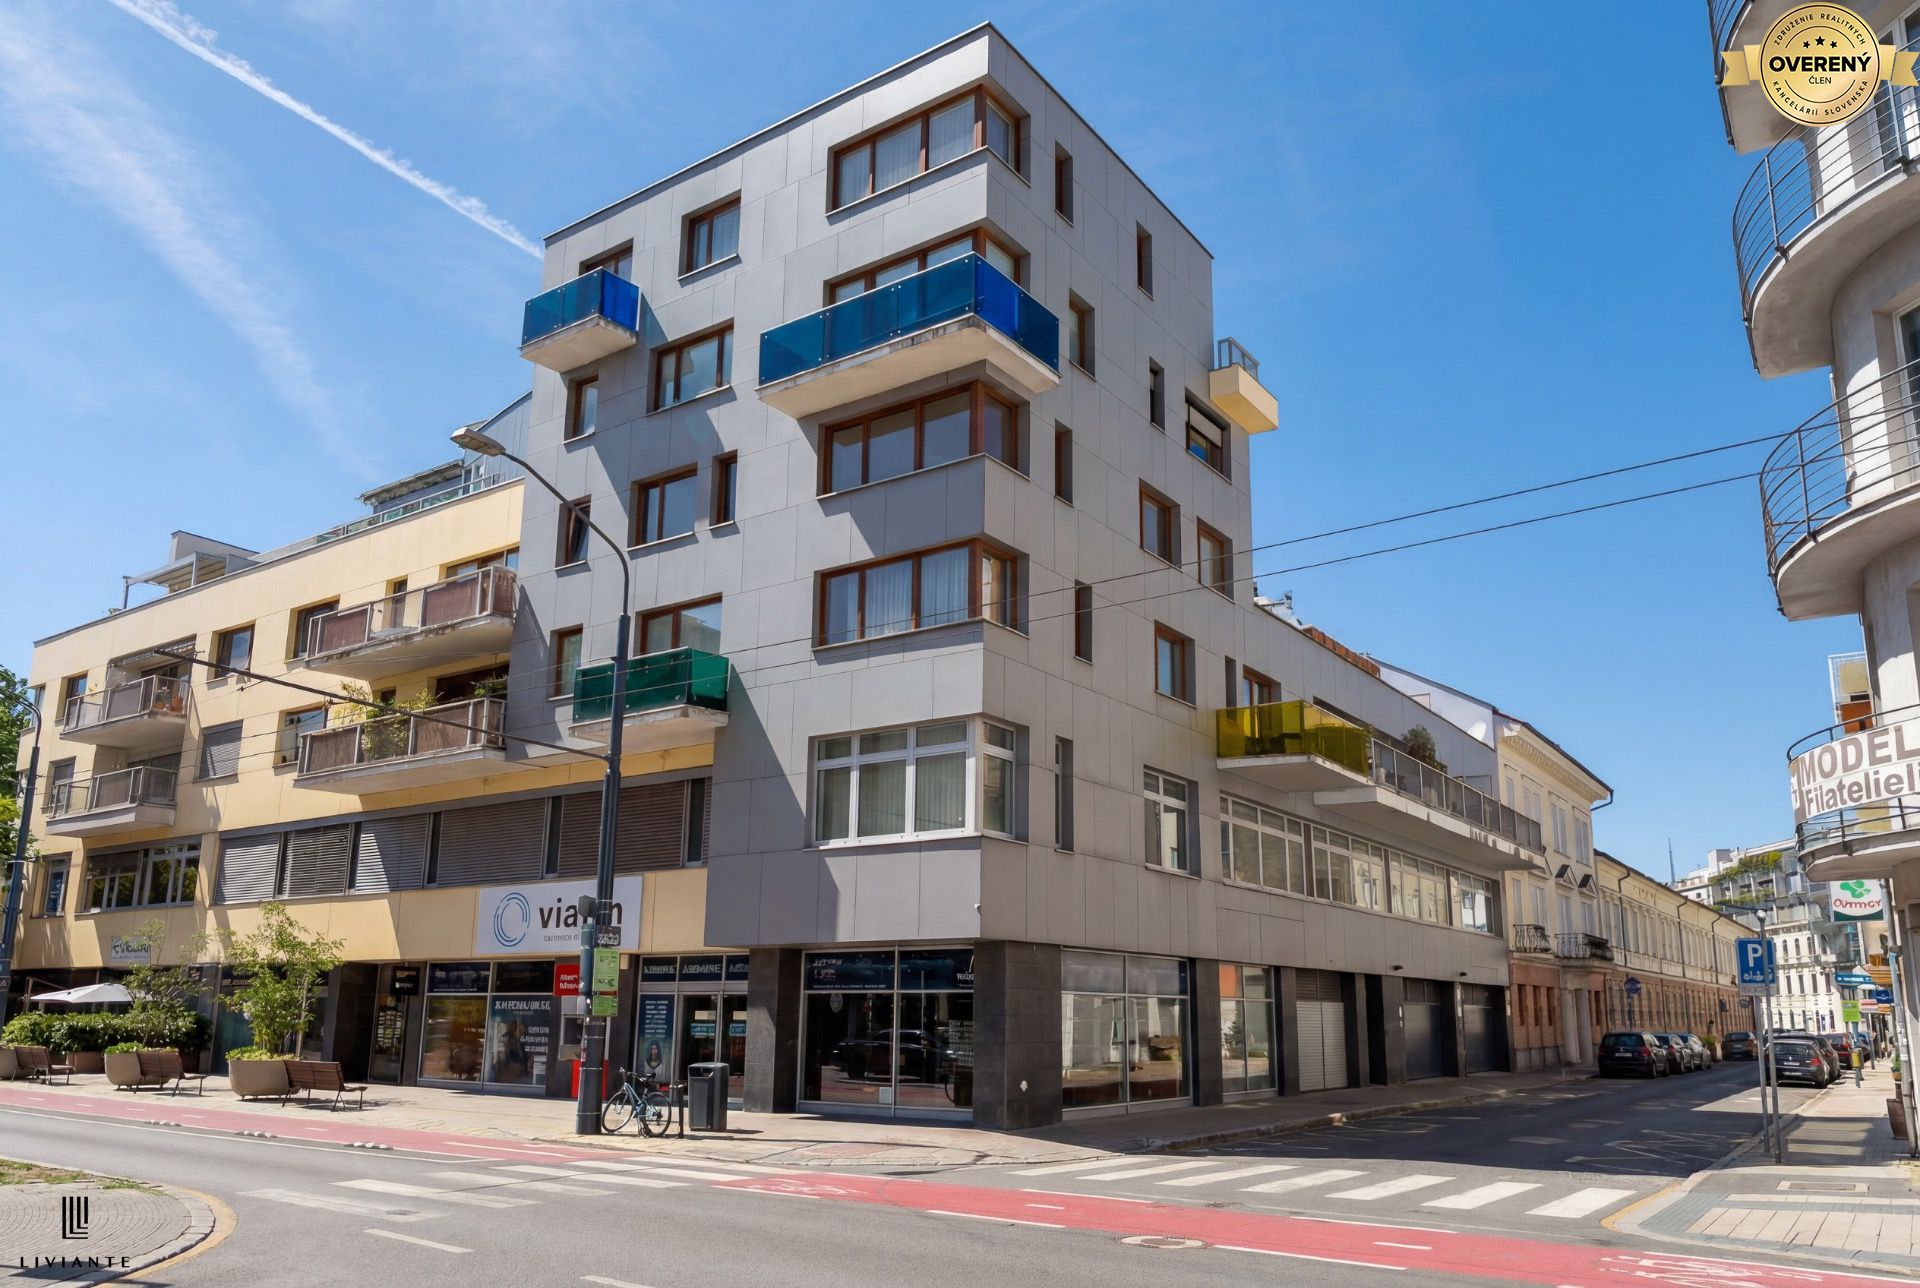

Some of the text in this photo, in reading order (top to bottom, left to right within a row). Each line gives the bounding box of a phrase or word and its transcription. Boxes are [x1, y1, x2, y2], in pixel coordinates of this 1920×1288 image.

[1800, 725, 1920, 787] MODEL
[1804, 761, 1920, 816] Filateliel
[1747, 943, 1763, 968] P
